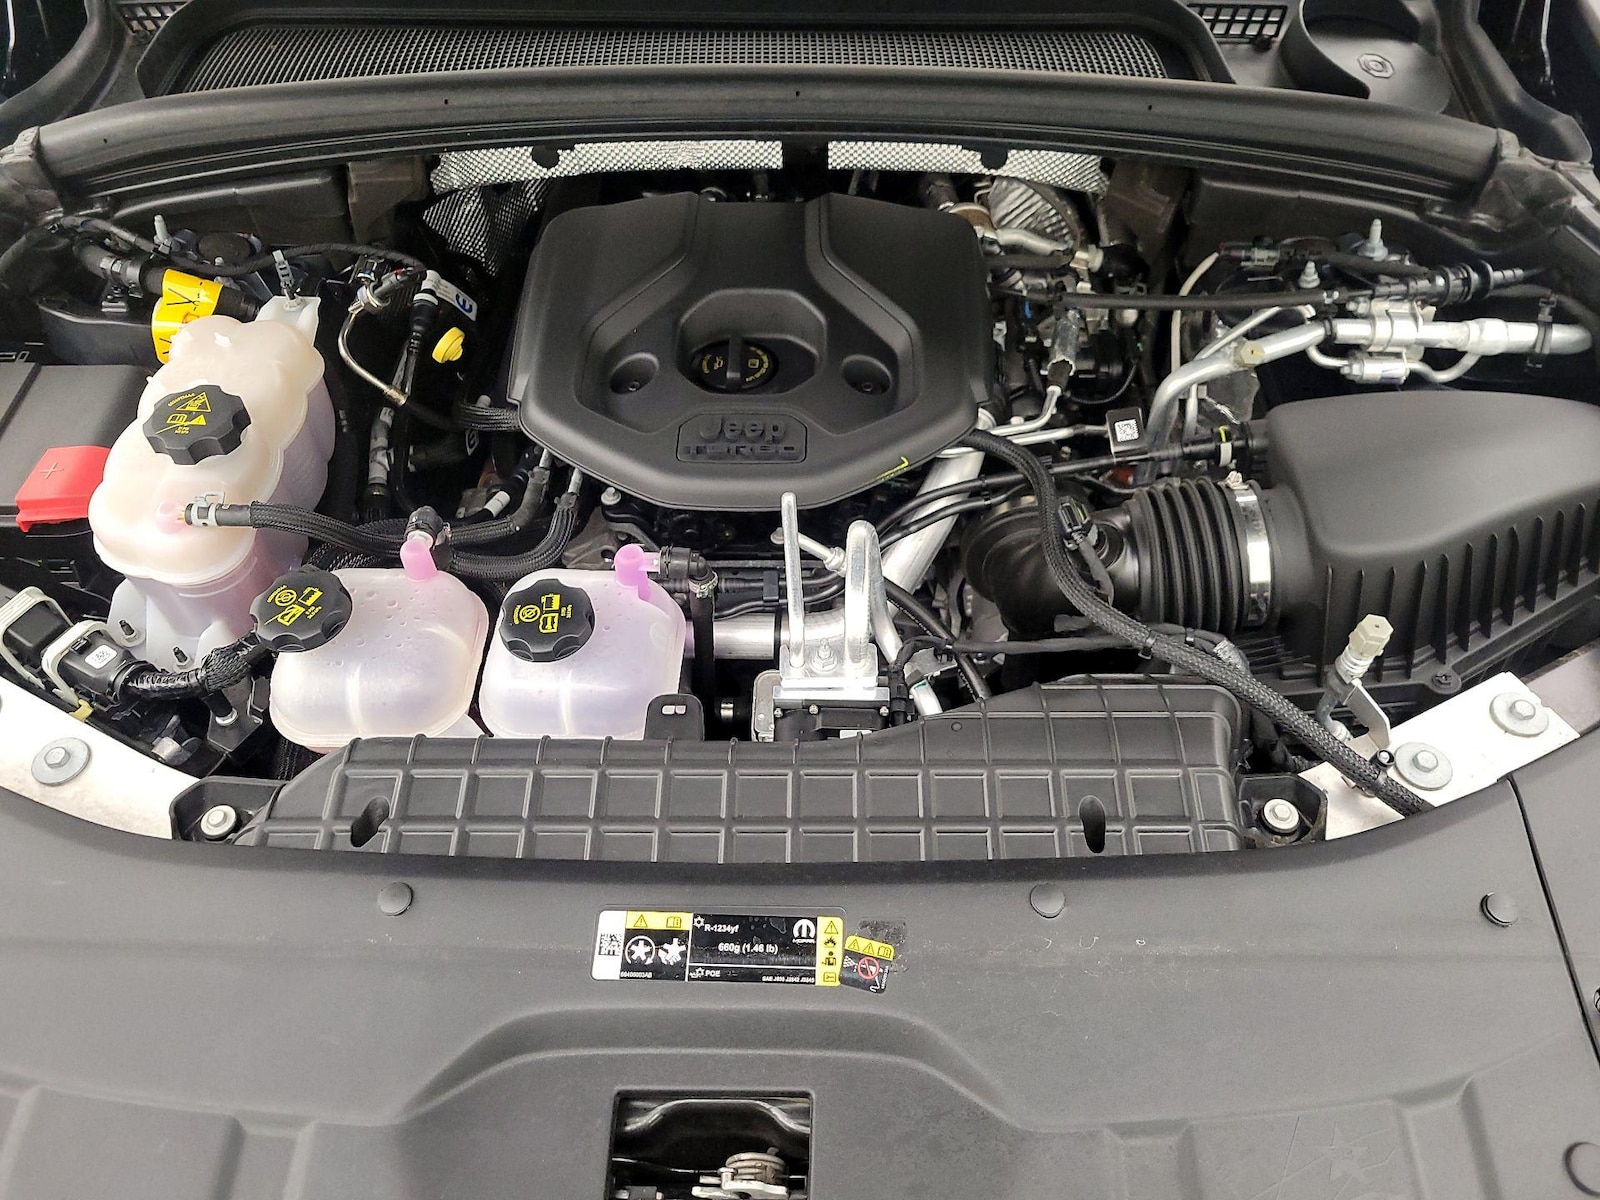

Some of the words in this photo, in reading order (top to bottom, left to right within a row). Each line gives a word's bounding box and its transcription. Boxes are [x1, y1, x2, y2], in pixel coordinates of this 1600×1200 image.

[698, 415, 785, 443] Jeep
[704, 924, 740, 934] R-1234yf
[718, 942, 741, 954] 660g
[742, 943, 765, 954] (1.46
[766, 944, 778, 955] lb)
